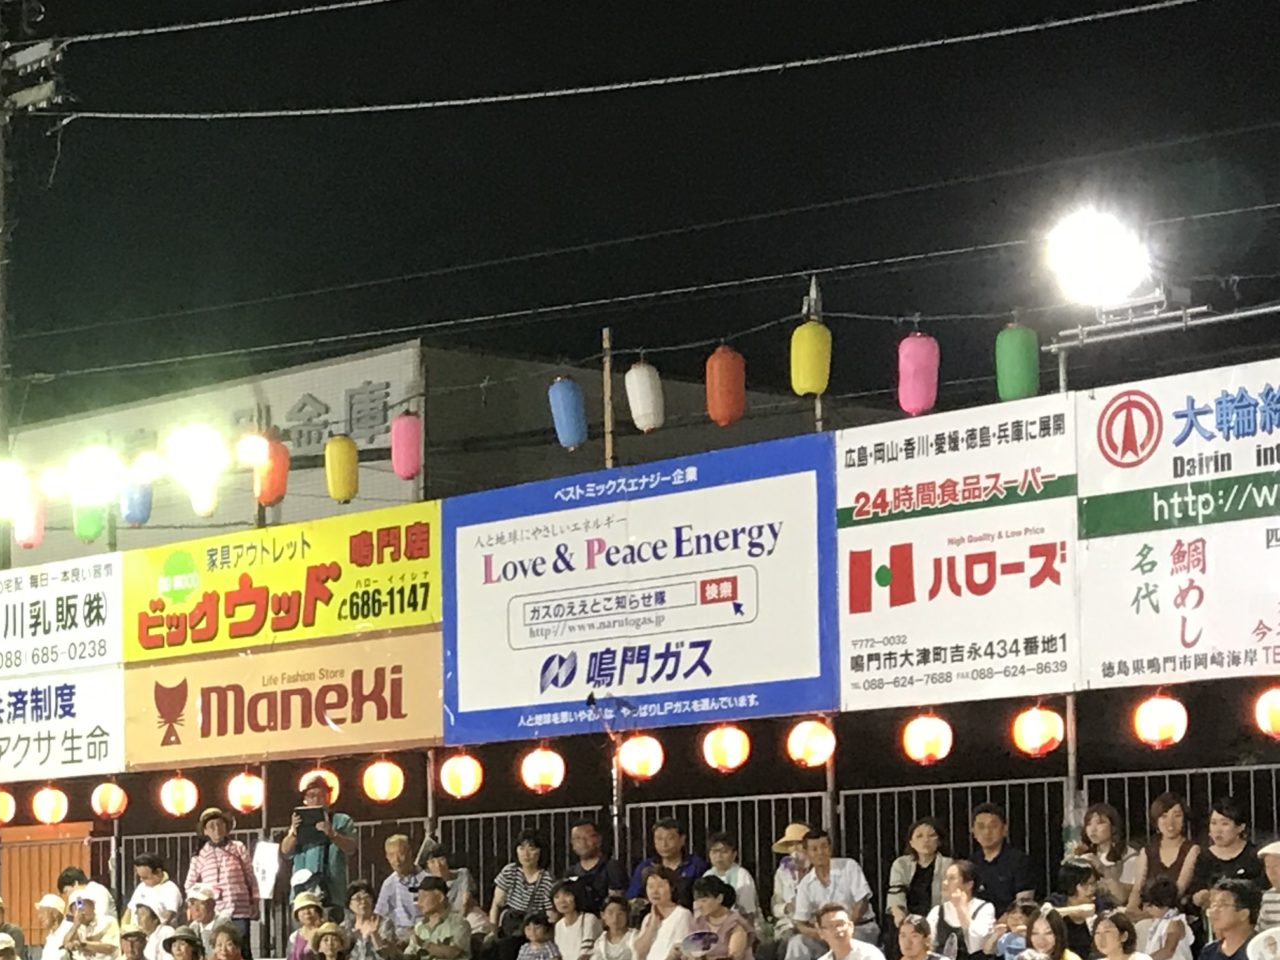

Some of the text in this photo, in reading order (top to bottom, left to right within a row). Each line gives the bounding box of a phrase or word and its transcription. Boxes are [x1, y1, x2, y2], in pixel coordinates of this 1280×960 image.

[553, 466, 698, 501] ベストミックスエナジー企業
[1172, 450, 1233, 479] Dairin
[853, 466, 1057, 520] 24時間食品スーパー
[206, 531, 312, 573] 家具アウトレット
[348, 520, 431, 568] 鳴門店
[1024, 526, 1045, 536] Price
[482, 519, 784, 586] Love & Peace Energy
[928, 540, 1067, 602] ハローズ
[704, 579, 734, 601] 検索
[1130, 543, 1161, 616] 名代
[1169, 536, 1207, 650] 鯛めし
[137, 561, 343, 651] ビッグウッド
[348, 582, 431, 622] 686-1147
[529, 590, 667, 622] ガスのええとこ知らせ隊
[585, 638, 713, 689] 鳴門ガス
[850, 632, 1068, 674] 鳴門市大津町吉永434番地1
[262, 667, 346, 687] Life Fashion Store
[862, 671, 954, 692] 088-624-7688
[971, 660, 1069, 682] 088-624-8639
